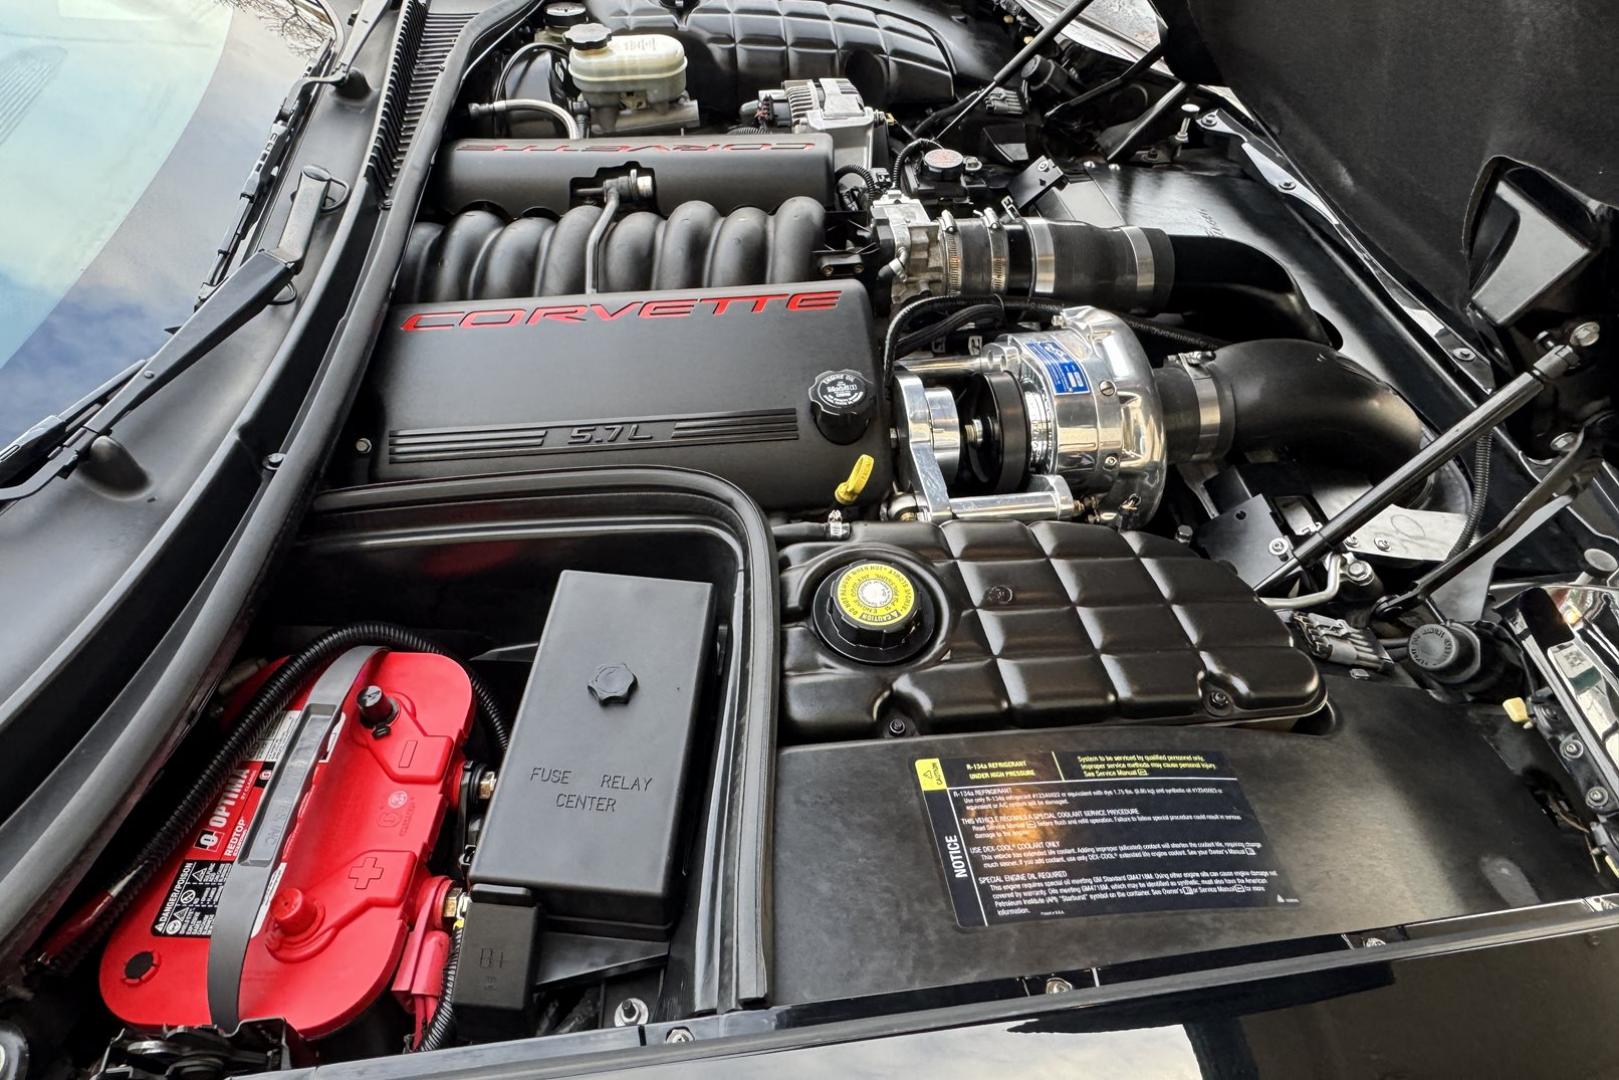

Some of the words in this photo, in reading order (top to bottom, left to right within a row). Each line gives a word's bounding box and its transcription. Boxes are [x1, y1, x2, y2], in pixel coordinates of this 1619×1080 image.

[400, 290, 842, 331] CORVETTE
[568, 424, 653, 444] 5.7L
[861, 613, 892, 622] CAUTION
[966, 762, 987, 770] R-134a
[987, 760, 1027, 769] REFRIGERANT
[530, 767, 572, 784] FUSE
[1005, 769, 1035, 777] PRESSURE
[600, 774, 653, 792] RELAY
[210, 768, 250, 828] OPTIMA
[952, 789, 974, 797] R-134a
[974, 787, 1012, 796] REFRIGERANT
[556, 793, 616, 812] CENTER
[1083, 809, 1106, 817] SERVICE
[1106, 808, 1139, 816] PROCEDURE
[224, 817, 246, 857] REDTOP
[1016, 842, 1044, 850] COOLANT
[1077, 846, 1095, 854] Adding
[945, 835, 968, 879] NOTICE
[978, 874, 1003, 883] SPECIAL
[1003, 873, 1026, 882] ENGINE
[1027, 872, 1037, 880] OIL
[1037, 870, 1067, 880] REQUIRED
[1002, 882, 1020, 890] engine
[1021, 880, 1043, 889] requires
[1043, 878, 1063, 887] special
[1070, 876, 1092, 884] meeting
[159, 862, 193, 920] DANGER/POISON
[1058, 886, 1081, 894] meeting
[1126, 882, 1138, 890] may
[994, 898, 1022, 907] Petroleum
[1022, 896, 1045, 904] Institute
[1089, 892, 1108, 900] symbol
